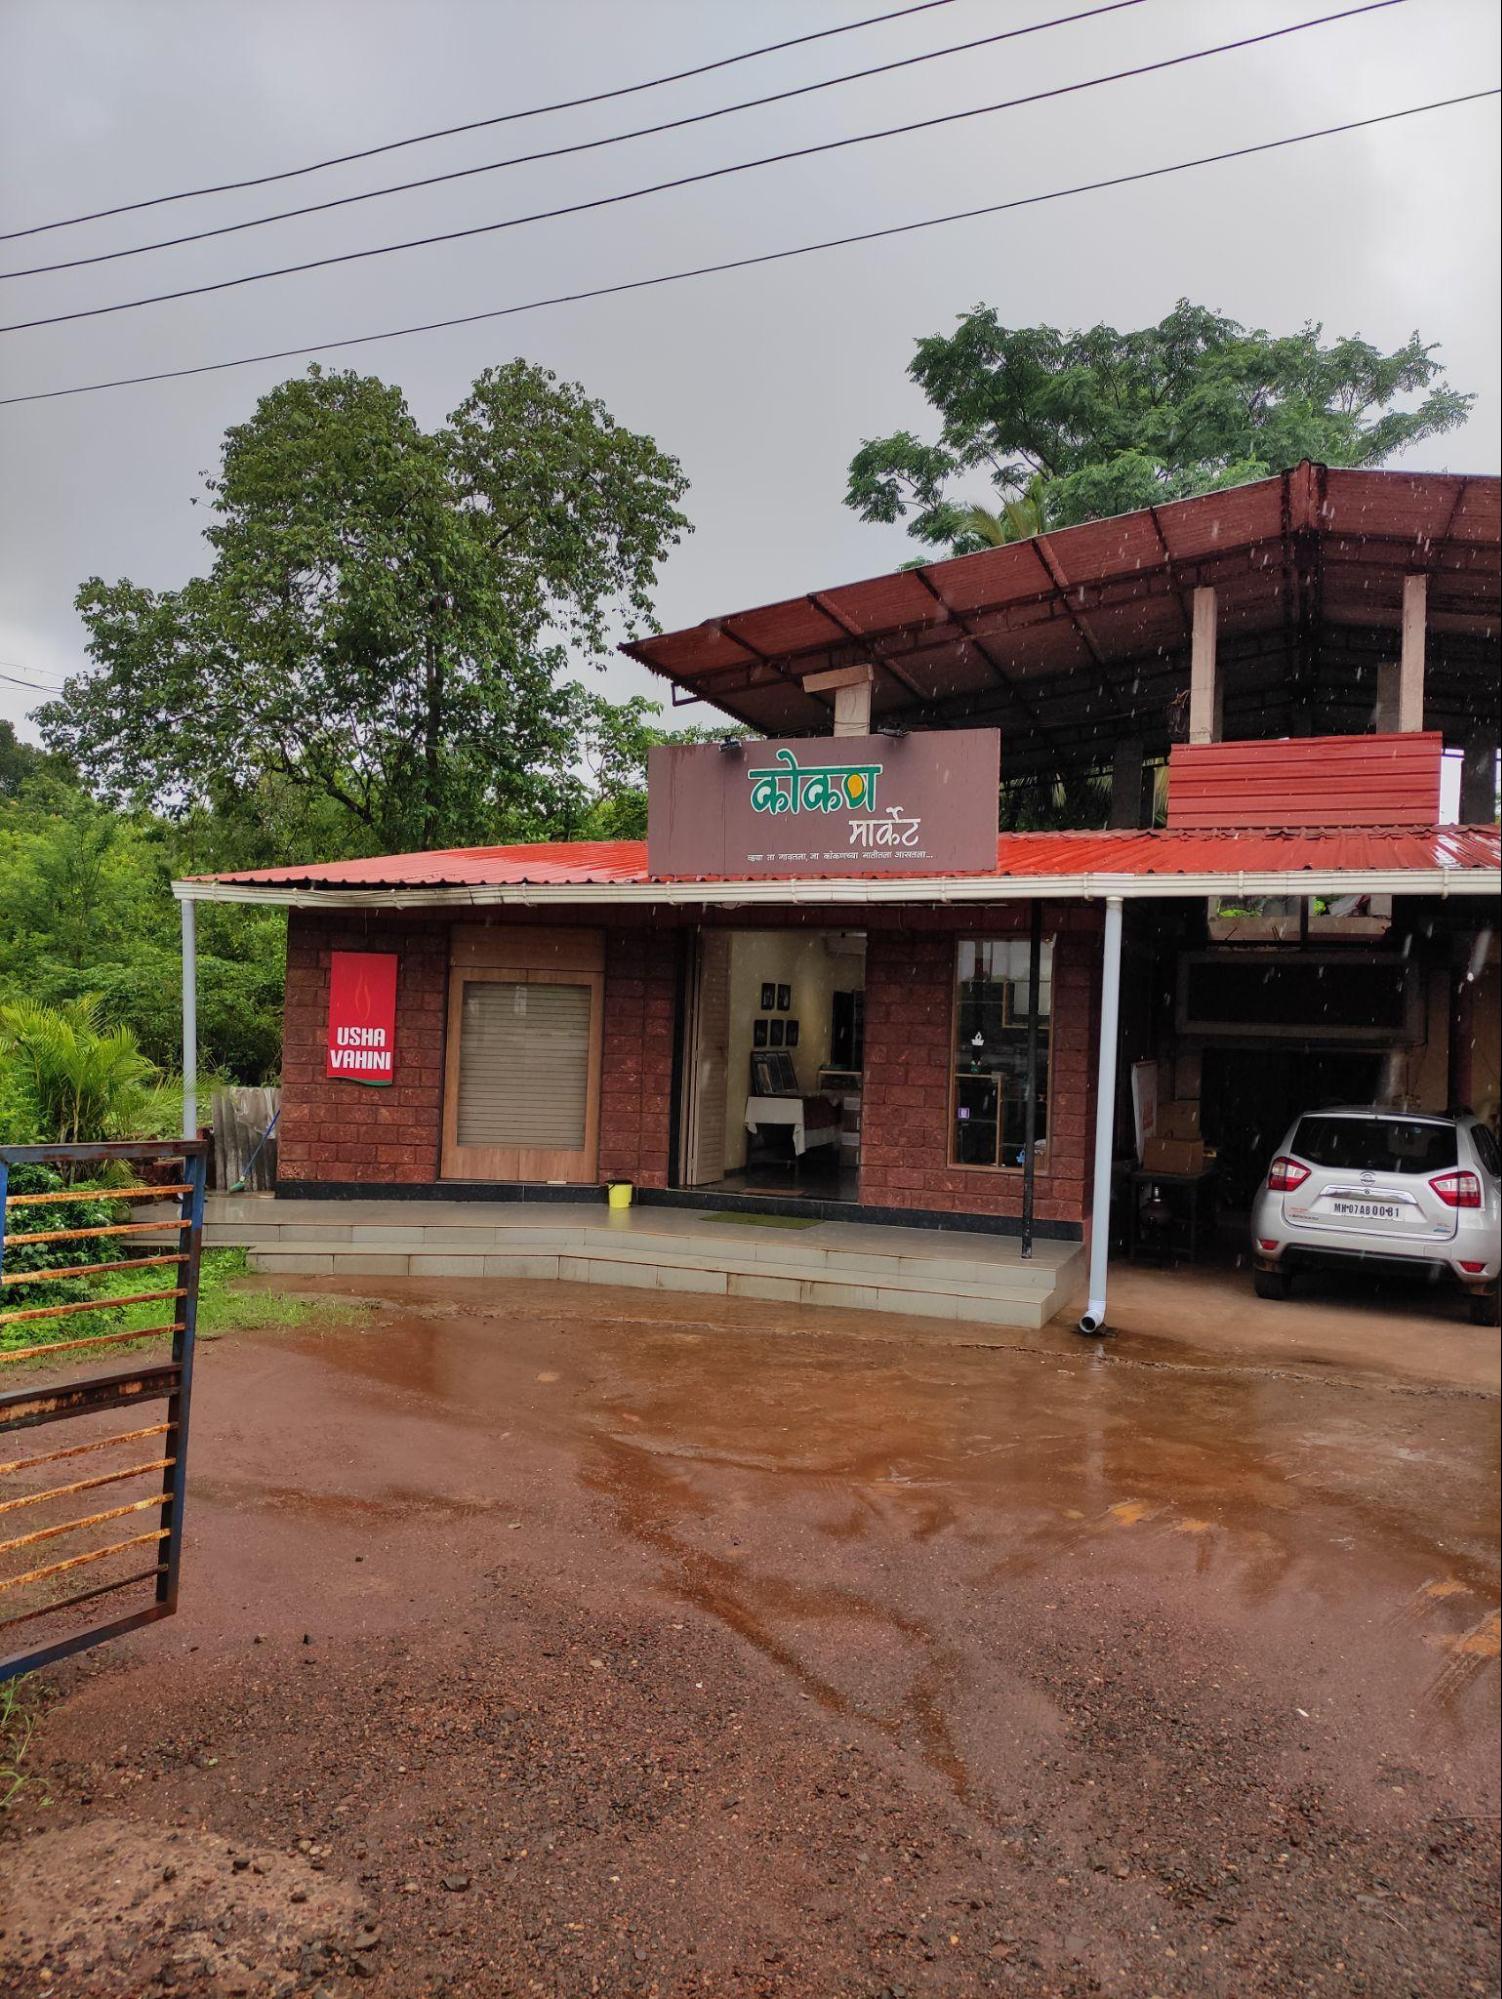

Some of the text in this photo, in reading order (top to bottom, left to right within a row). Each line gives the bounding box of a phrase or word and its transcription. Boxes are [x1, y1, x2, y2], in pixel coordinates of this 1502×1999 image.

[748, 748, 883, 815] कोकण
[849, 806, 921, 847] मार्केट
[336, 1026, 386, 1047] USHA
[329, 1049, 392, 1071] VAHINI
